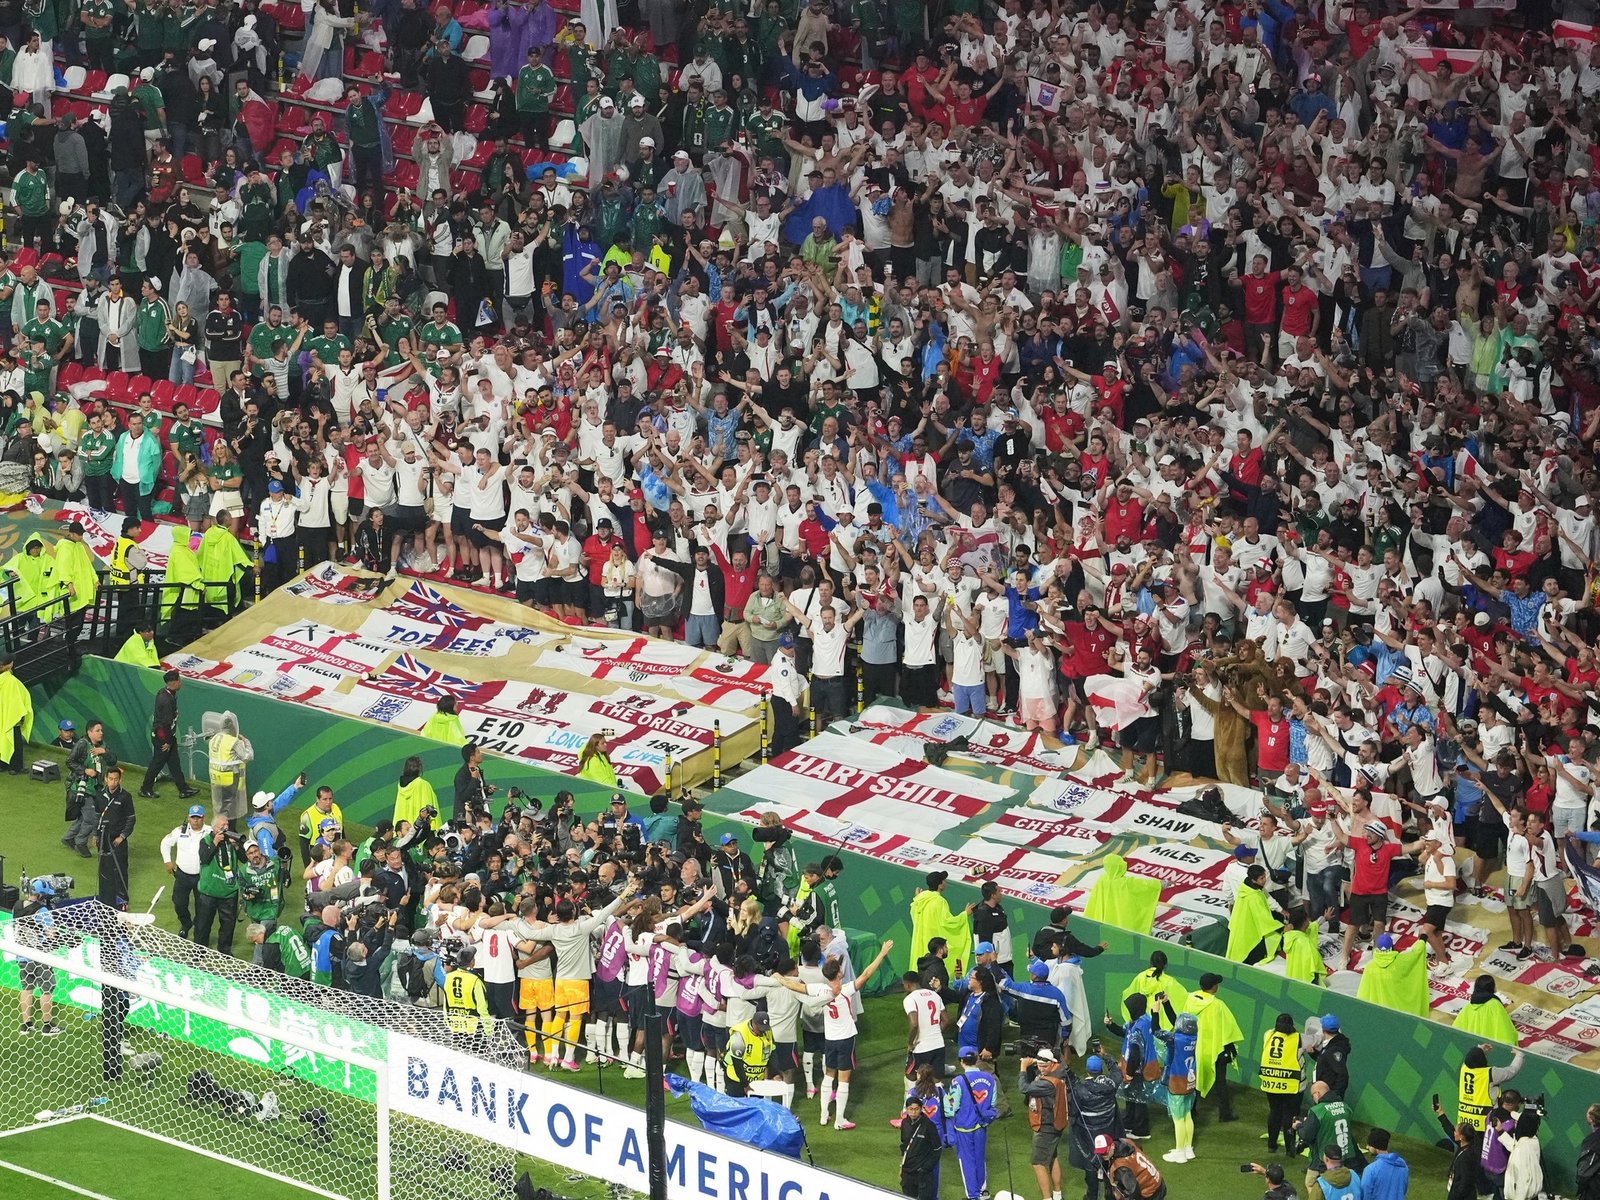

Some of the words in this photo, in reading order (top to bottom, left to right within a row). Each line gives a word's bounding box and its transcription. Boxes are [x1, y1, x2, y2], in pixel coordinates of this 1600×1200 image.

[743, 54, 748, 63] 3
[551, 505, 557, 513] 8
[699, 579, 704, 588] 4
[271, 639, 293, 649] THE
[291, 643, 348, 667] BIRCHWOOD
[1090, 643, 1096, 652] 7
[1483, 641, 1489, 651] 9
[1417, 669, 1426, 678] 26
[477, 717, 498, 733] E
[497, 720, 525, 738] 10
[600, 702, 638, 721] THE
[637, 714, 708, 739] ORIENT
[1268, 736, 1275, 746] 16
[783, 754, 956, 812] HARTSHILL
[1133, 813, 1195, 833] SHAW
[1149, 846, 1205, 864] MILES
[1000, 867, 1033, 880] CITY
[1037, 874, 1058, 884] FC
[1128, 862, 1214, 887] RUNNING
[927, 1000, 939, 1026] 2
[407, 1056, 530, 1135] BANK
[547, 1103, 603, 1156] OF
